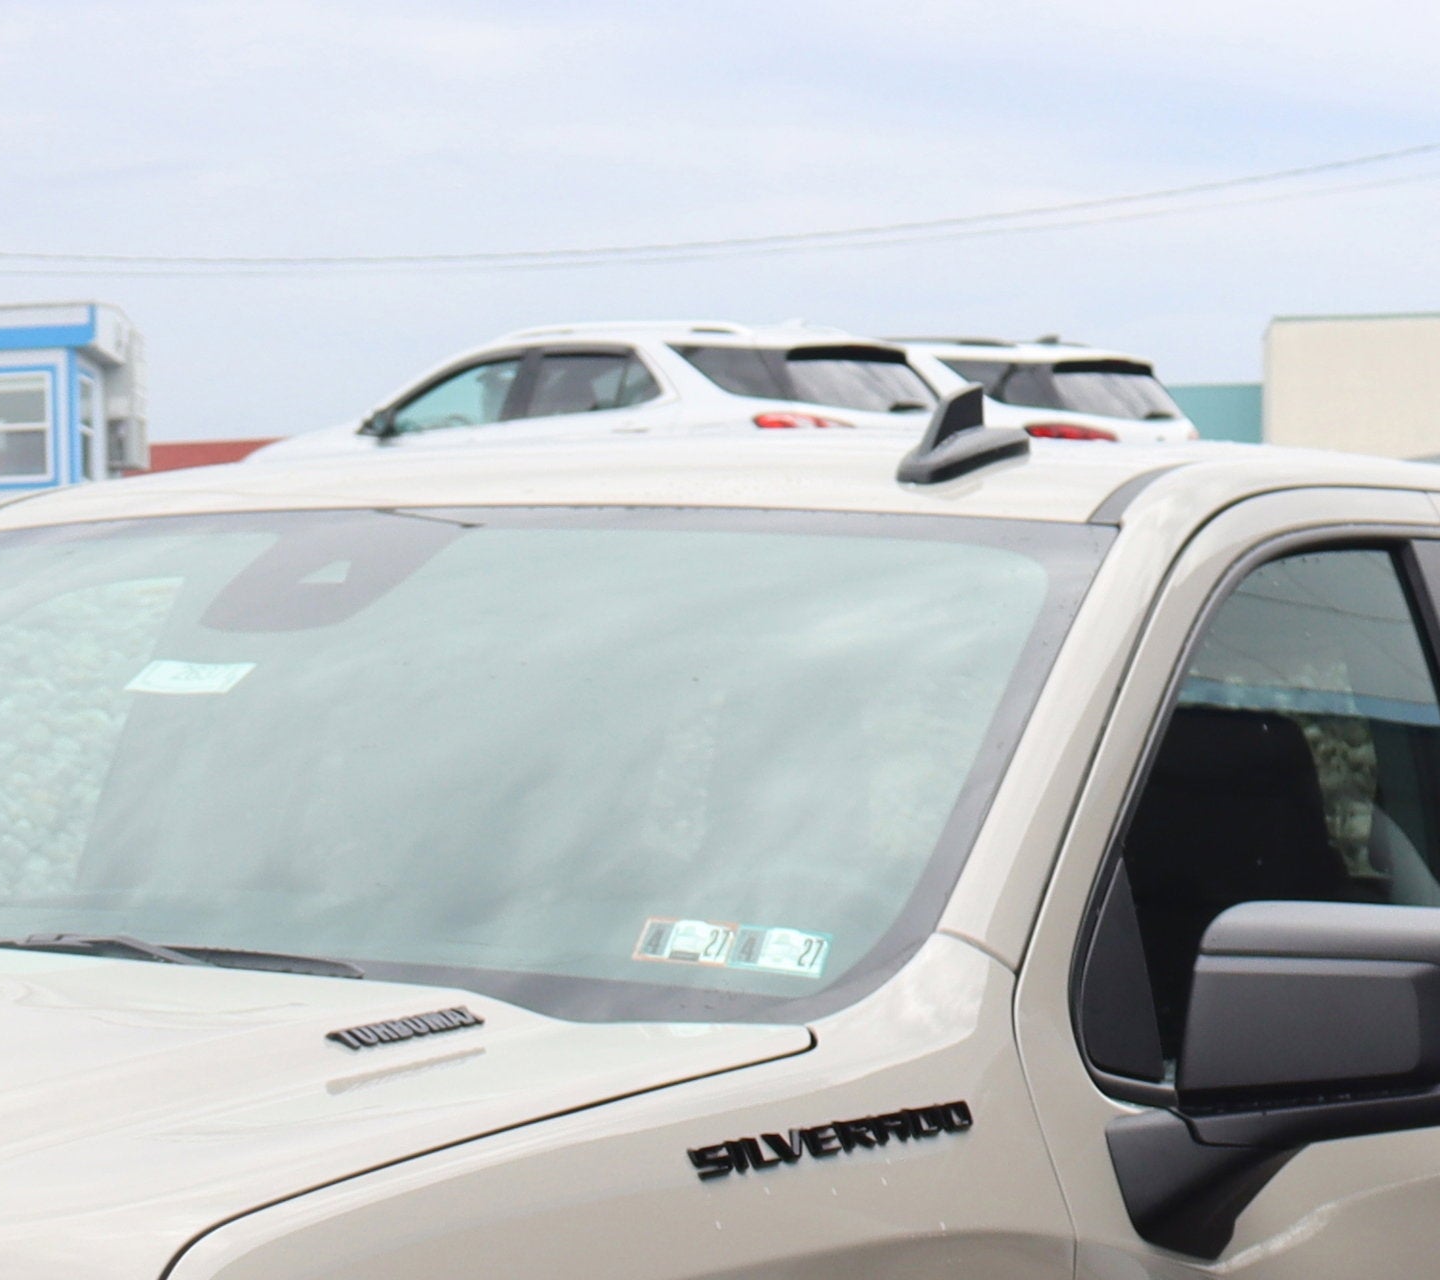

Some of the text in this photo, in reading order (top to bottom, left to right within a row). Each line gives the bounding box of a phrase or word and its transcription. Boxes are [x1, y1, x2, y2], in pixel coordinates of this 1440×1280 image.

[703, 928, 730, 958] 27
[797, 937, 824, 969] 27
[687, 1099, 973, 1182] SILVERADO
